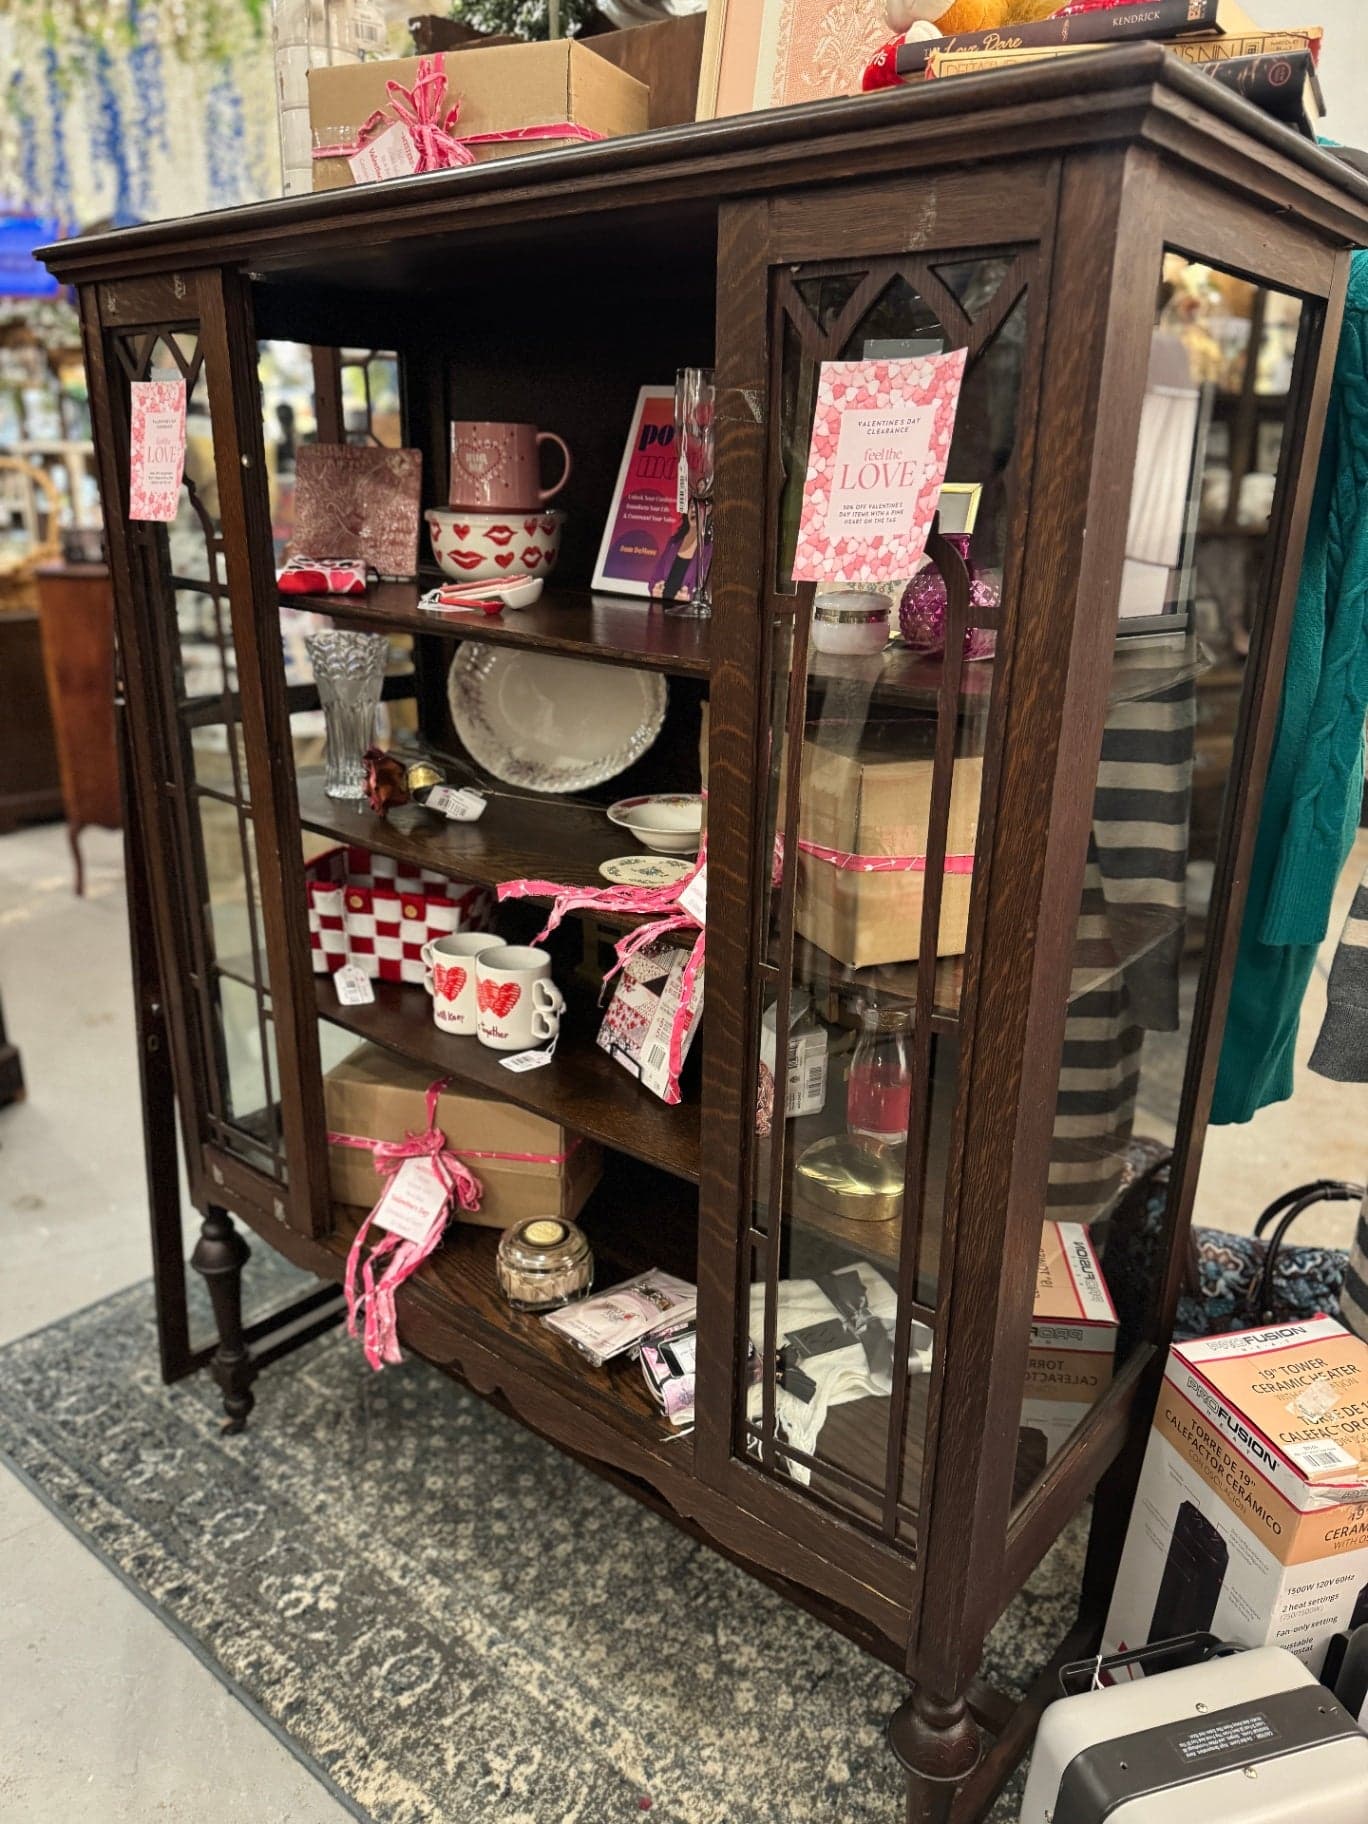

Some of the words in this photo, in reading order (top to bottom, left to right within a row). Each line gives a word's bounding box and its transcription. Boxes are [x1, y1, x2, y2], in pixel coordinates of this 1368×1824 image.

[1112, 11, 1160, 27] KENDRICK
[983, 33, 1023, 51] Dare
[906, 417, 920, 425] DAY
[866, 426, 909, 435] CLEARANCE
[147, 446, 177, 464] LOVE
[864, 448, 884, 462] feel
[885, 448, 903, 460] the
[839, 460, 917, 490] LOVE
[1258, 1367, 1277, 1381] 19"
[1278, 1357, 1329, 1376] TOWER
[1251, 1375, 1311, 1394] CERAMIC
[1341, 1404, 1364, 1417] DE
[1191, 1418, 1221, 1457] TORRE
[1223, 1454, 1237, 1473] DE
[1239, 1468, 1256, 1487] 19"
[1165, 1409, 1225, 1477] CALEFACTOR
[1225, 1473, 1282, 1536] CERÁMICO
[1288, 1583, 1314, 1595] 1500W
[1316, 1578, 1336, 1589] 120V
[1335, 1574, 1355, 1584] 60Hz
[1282, 1605, 1288, 1613] 2
[1288, 1601, 1306, 1611] heat
[1308, 1594, 1339, 1606] settings
[1311, 1616, 1338, 1628] setting
